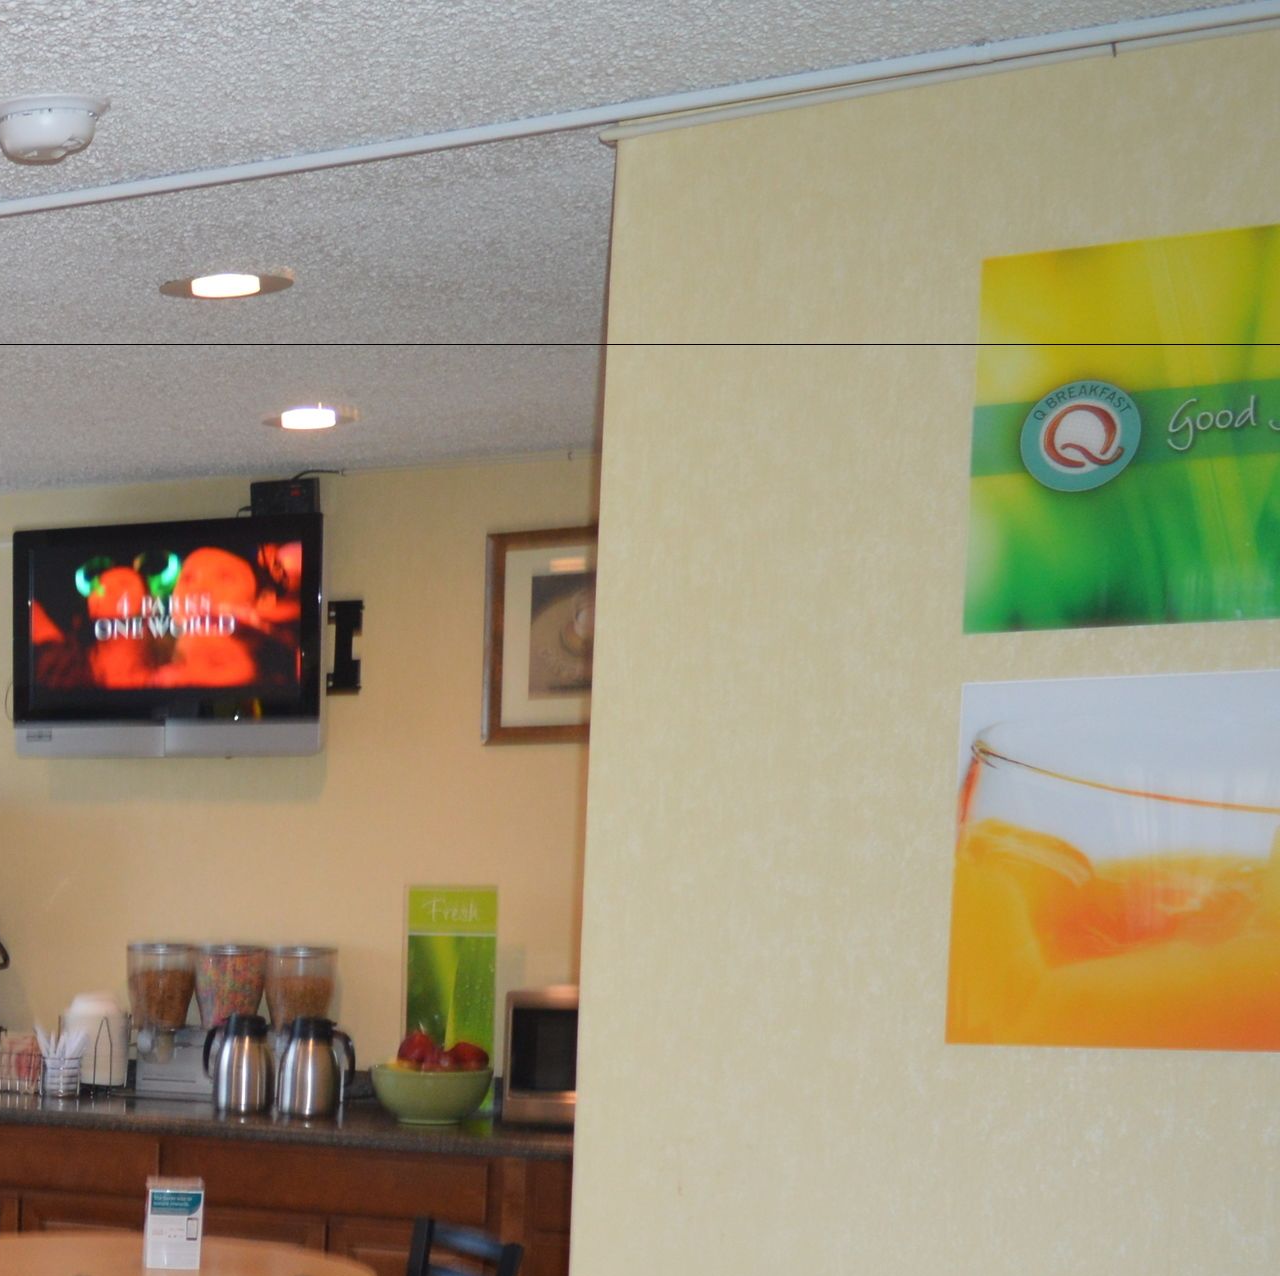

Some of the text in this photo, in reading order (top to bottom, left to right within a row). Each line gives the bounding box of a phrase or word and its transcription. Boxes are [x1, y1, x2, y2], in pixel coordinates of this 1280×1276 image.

[1045, 384, 1132, 413] BREAKFAST
[1043, 404, 1125, 469] Q
[1167, 395, 1257, 451] Good
[141, 593, 211, 618] PARKS
[94, 614, 236, 641] ONE WORLD
